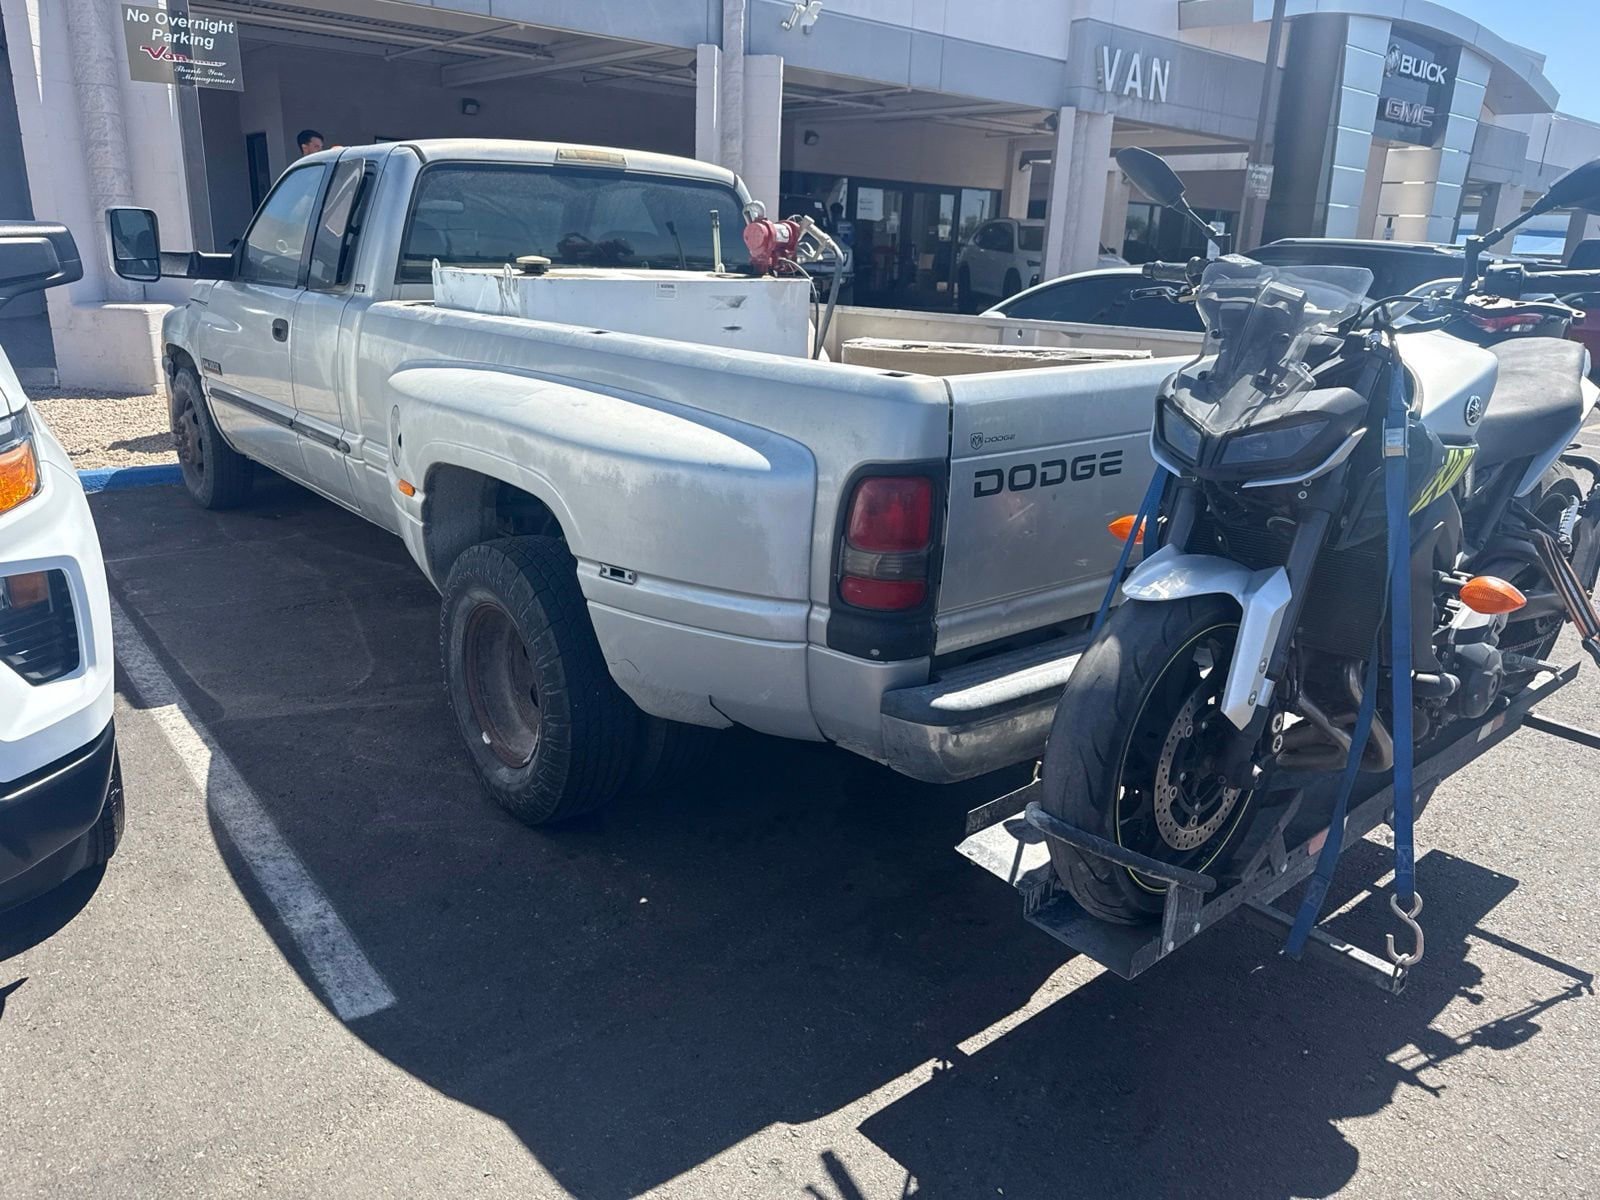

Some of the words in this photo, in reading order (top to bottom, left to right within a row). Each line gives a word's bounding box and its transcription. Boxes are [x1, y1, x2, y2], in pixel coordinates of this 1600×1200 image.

[127, 8, 149, 23] No
[155, 12, 234, 34] Overnight
[152, 28, 214, 50] Parking
[174, 65, 202, 74] Thank
[1103, 45, 1170, 103] VAN
[1400, 54, 1448, 85] BUICK
[1384, 97, 1435, 127] GMC
[984, 433, 1016, 443] DODGE
[973, 449, 1123, 498] DODGE
